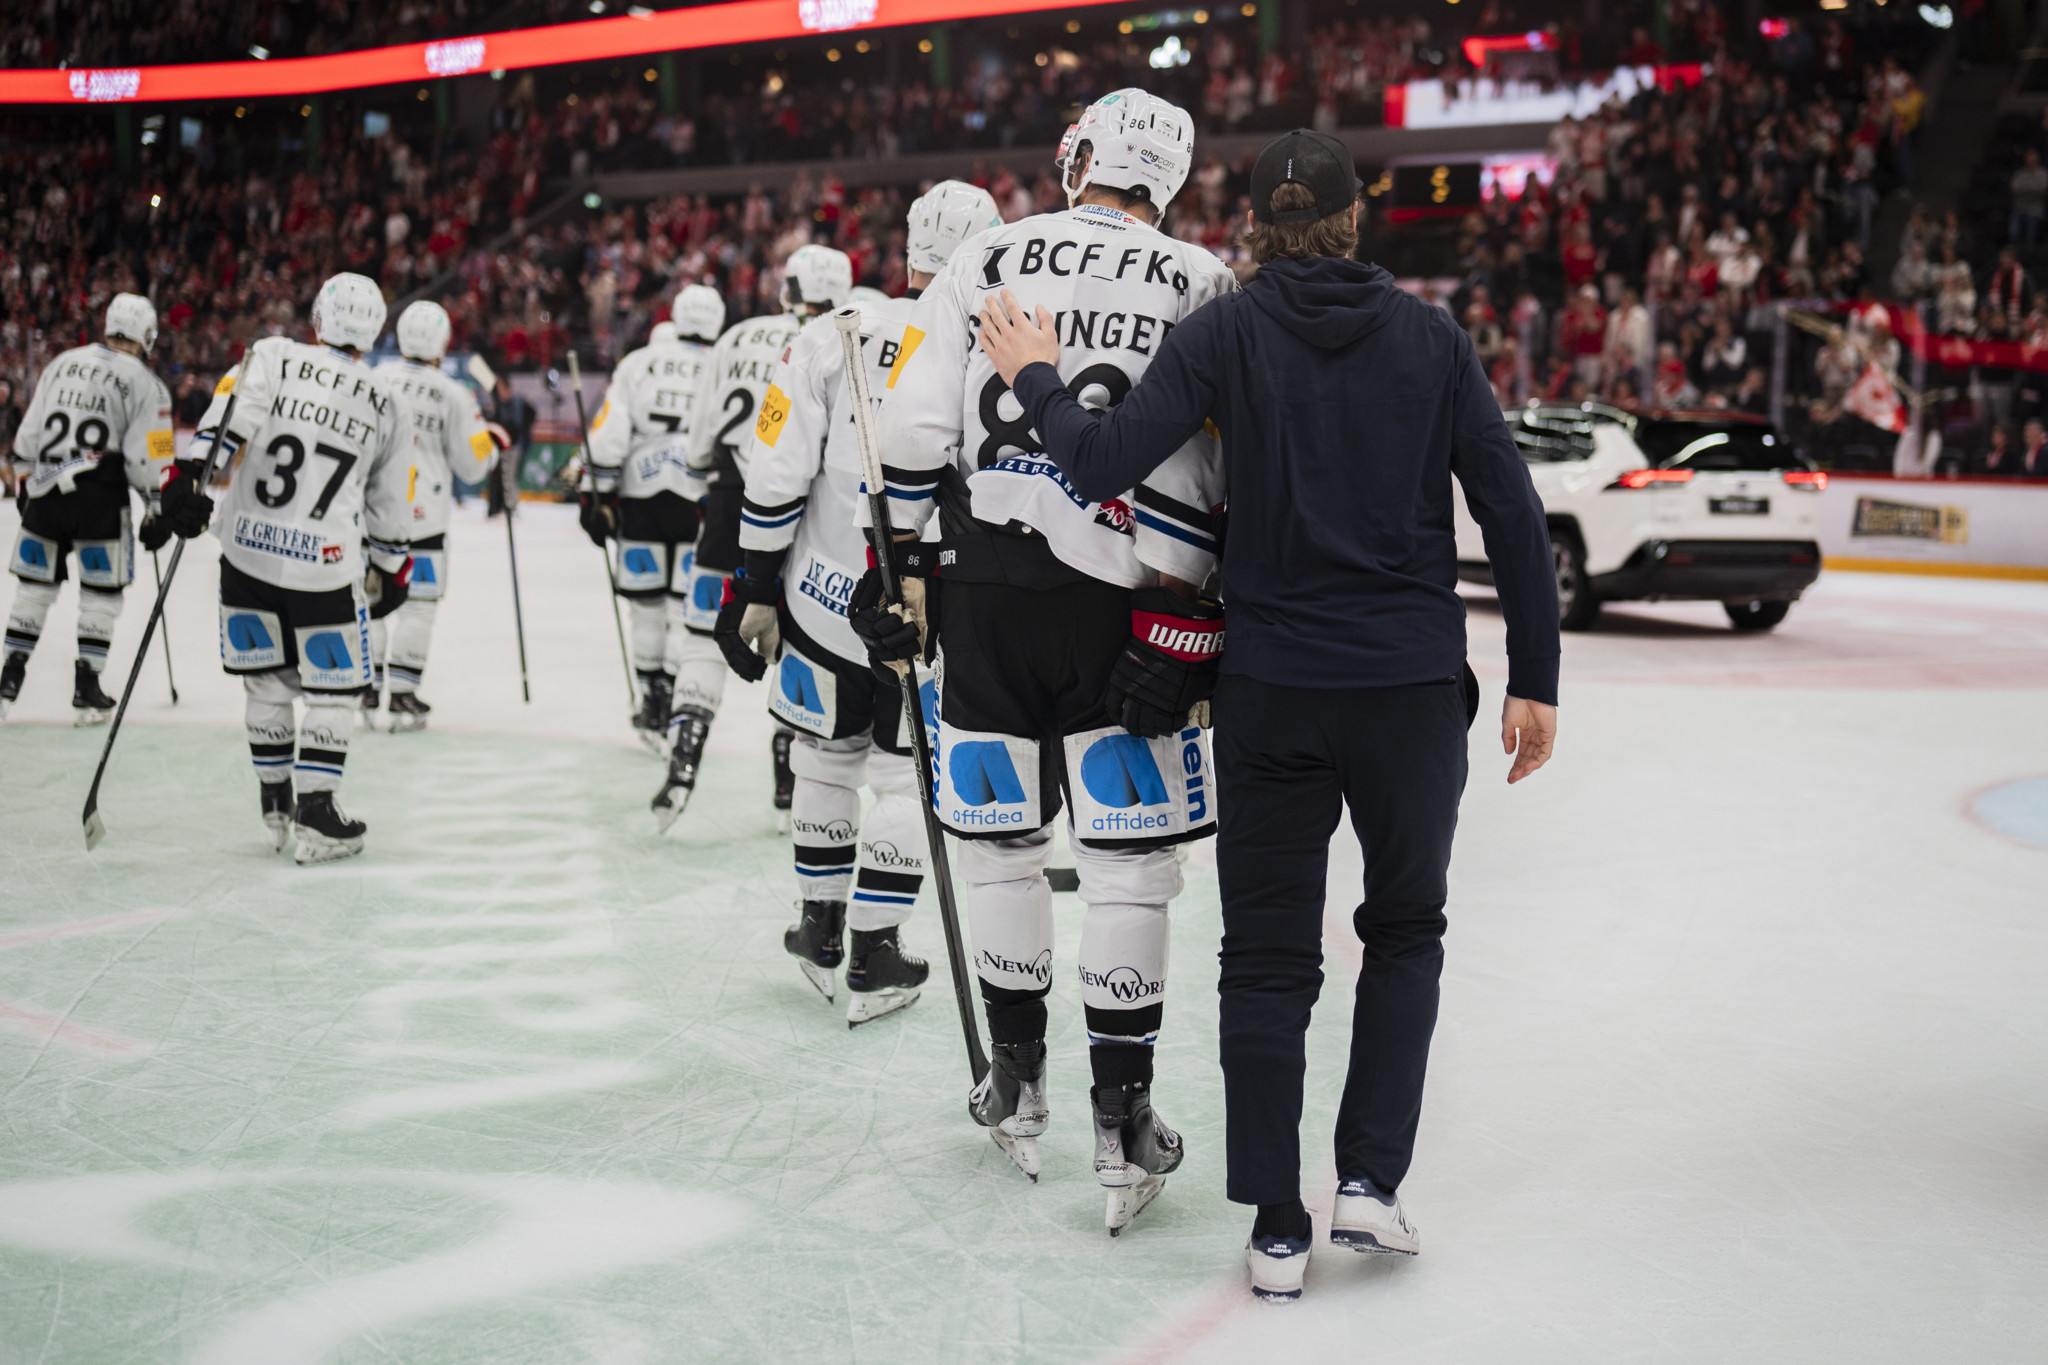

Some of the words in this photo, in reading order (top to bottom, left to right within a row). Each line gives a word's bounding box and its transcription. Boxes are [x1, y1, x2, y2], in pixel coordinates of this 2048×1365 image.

[57, 388, 106, 412] LILJA
[270, 395, 376, 447] NICOLET
[255, 434, 358, 521] 37
[235, 516, 251, 536] LE
[252, 522, 320, 552] GRUYÈRE
[805, 557, 825, 587] LE
[907, 554, 920, 567] 86
[358, 607, 371, 680] Klein
[775, 697, 823, 728] affidea
[1181, 726, 1207, 823] lein
[953, 809, 1023, 825] affidea
[1092, 812, 1169, 831] affidea
[1342, 1185, 1365, 1193] balance
